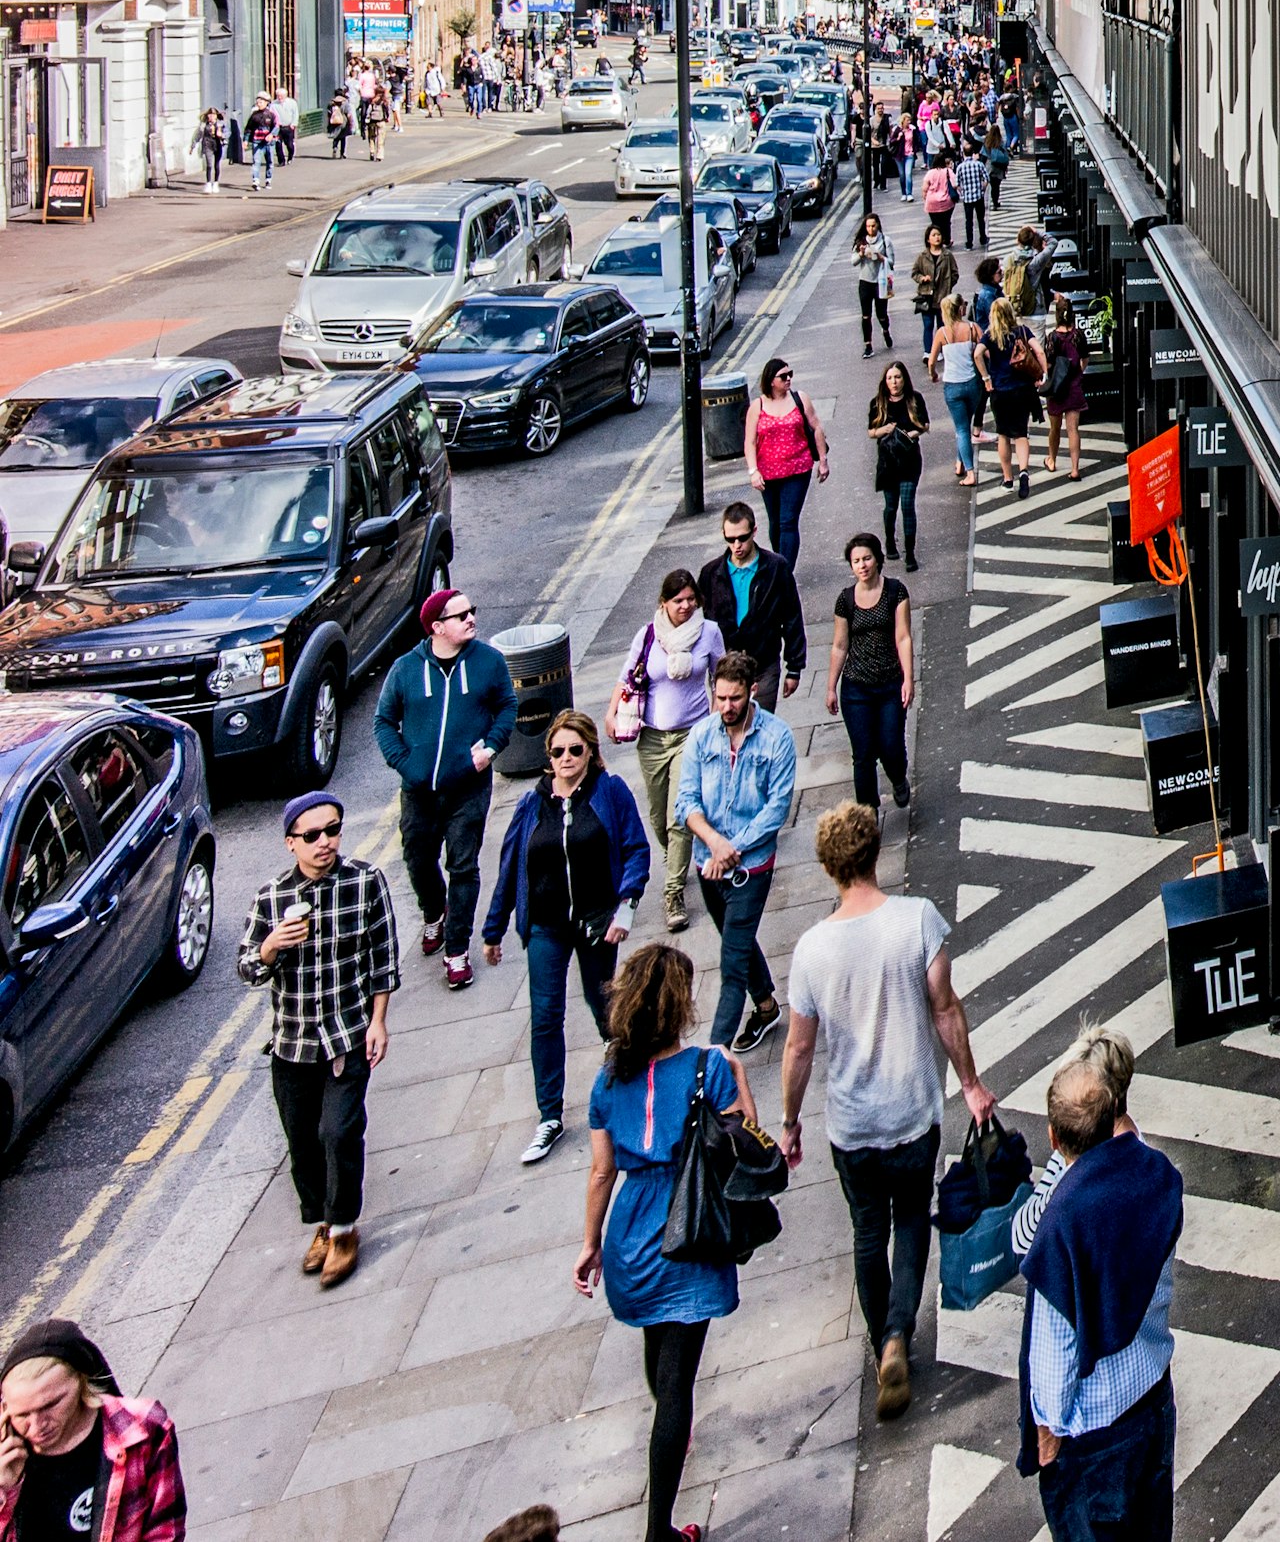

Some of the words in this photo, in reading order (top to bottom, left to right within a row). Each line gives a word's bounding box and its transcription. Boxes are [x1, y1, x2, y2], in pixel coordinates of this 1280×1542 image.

[54, 171, 85, 184] DIRTY
[48, 185, 85, 198] BURGER
[1141, 449, 1173, 472] SHOREDITCH
[1148, 463, 1168, 478] DESIGN
[1146, 471, 1172, 489] TRIANGLE
[32, 651, 97, 665] LAND
[110, 642, 194, 659] ROVER
[1110, 642, 1149, 656] WANDERING
[1150, 639, 1172, 649] MINDS
[1159, 784, 1185, 796] austrian
[1185, 782, 1200, 790] wine
[1194, 948, 1260, 1015] TUE
